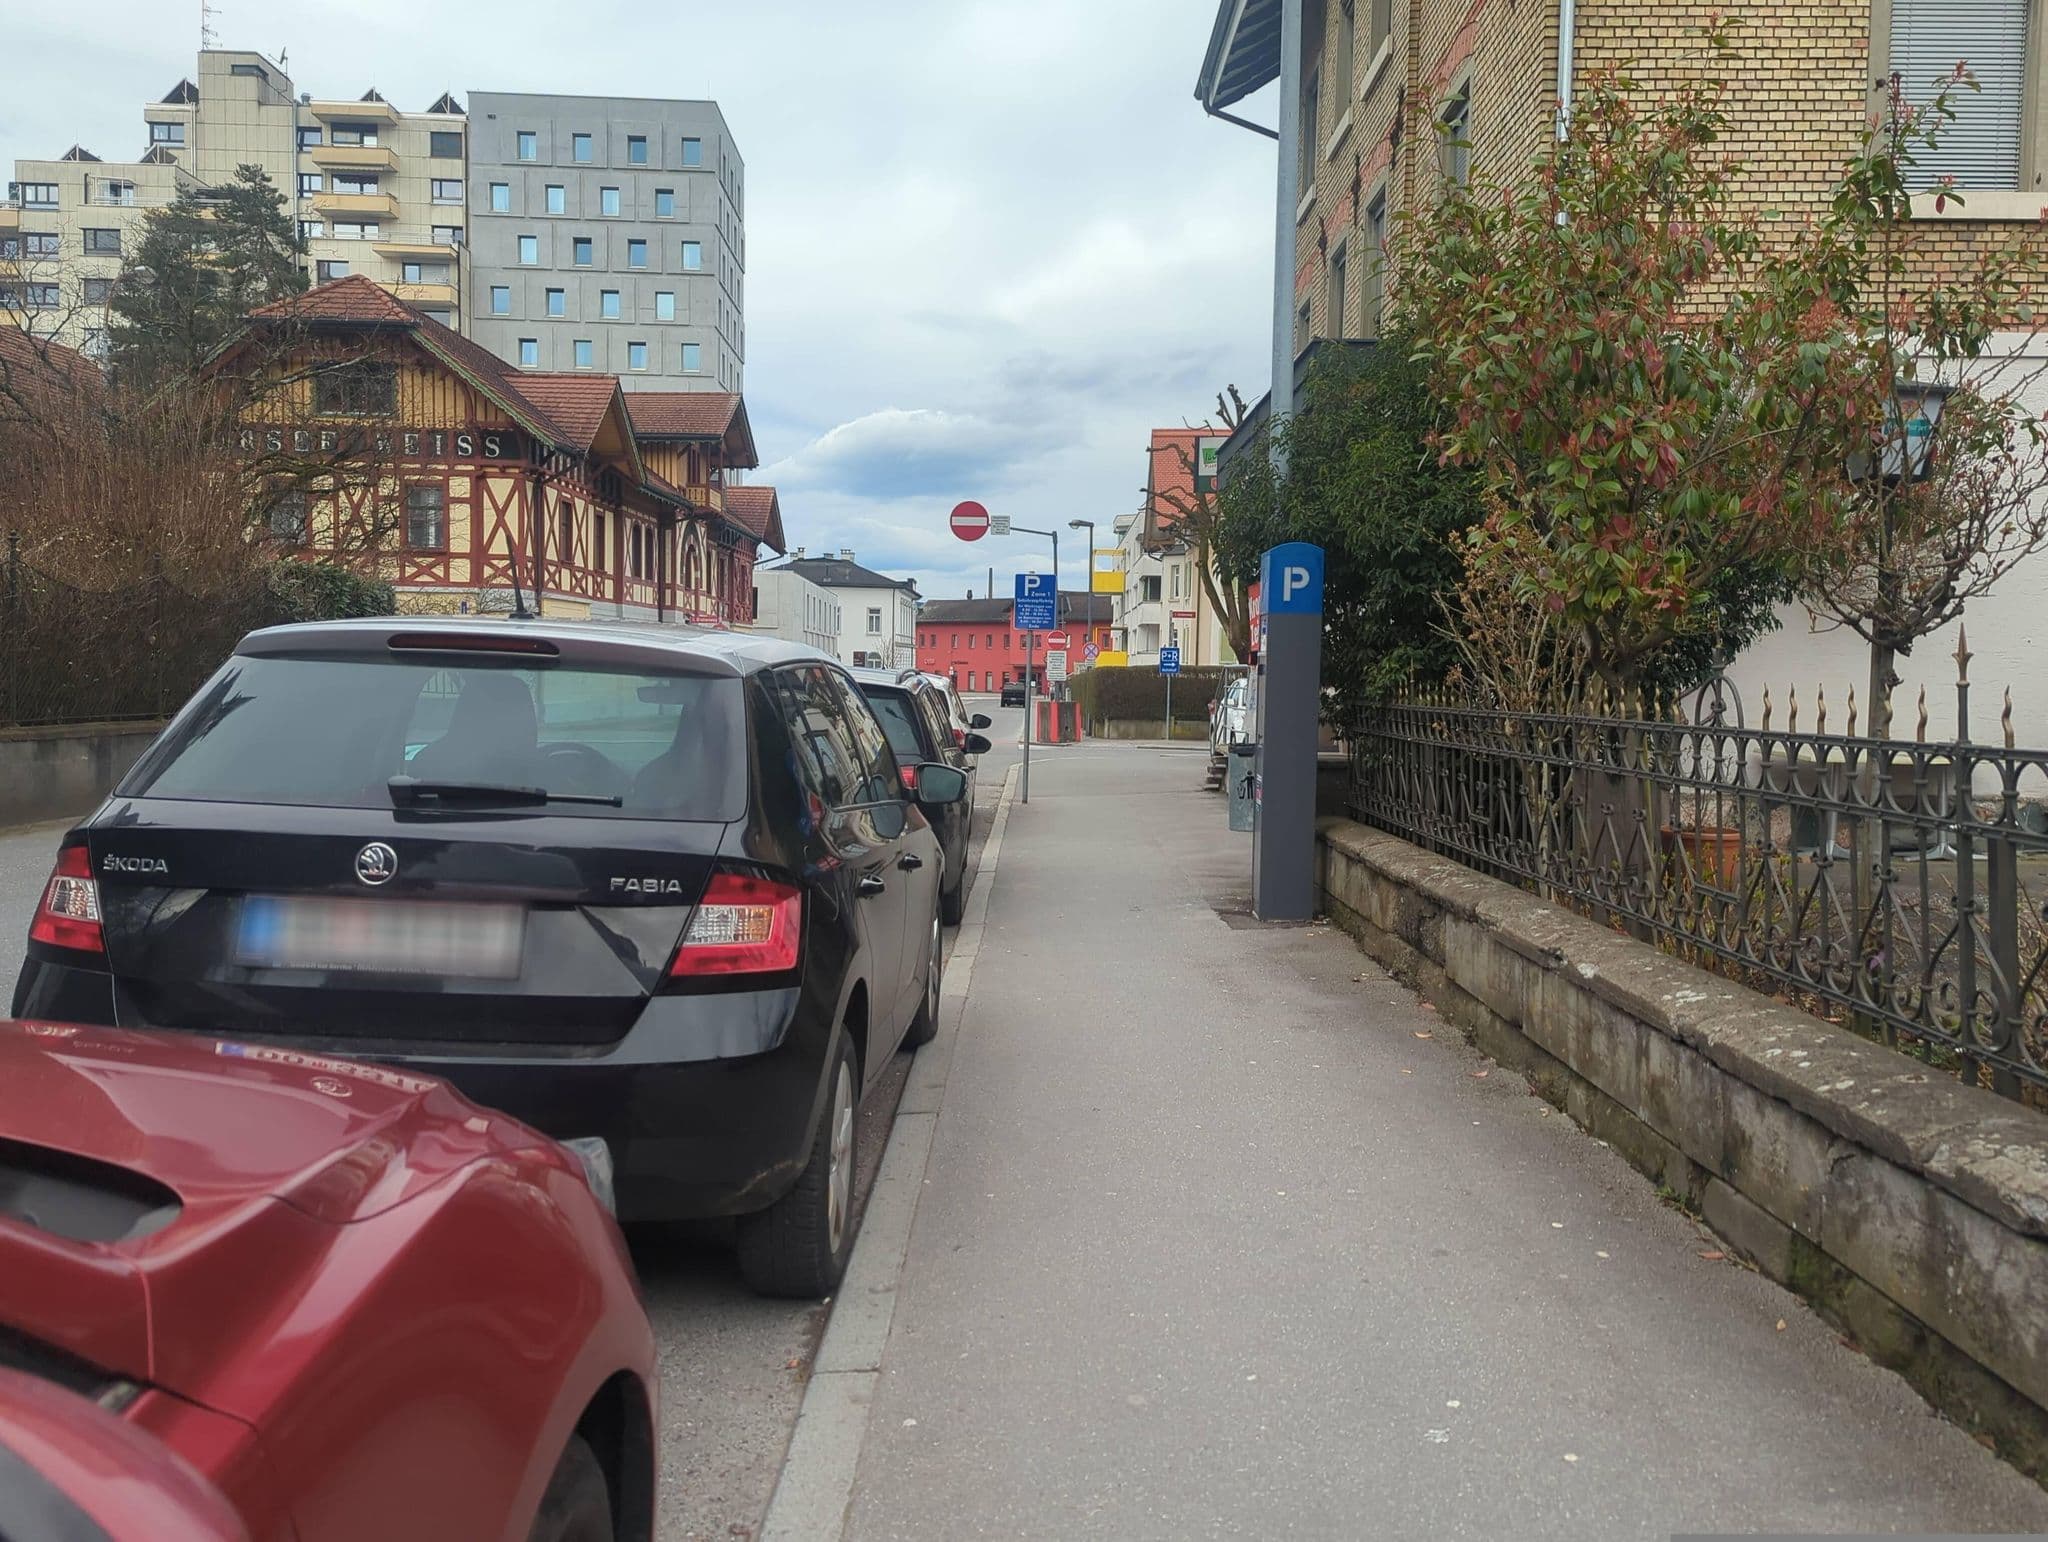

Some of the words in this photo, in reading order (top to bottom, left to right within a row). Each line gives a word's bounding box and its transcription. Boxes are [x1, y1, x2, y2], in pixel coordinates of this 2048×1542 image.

[1024, 575, 1041, 597] P
[1282, 566, 1310, 602] P
[1161, 650, 1178, 662] P+R
[103, 853, 169, 874] ŠKODA
[610, 877, 683, 894] FABIA
